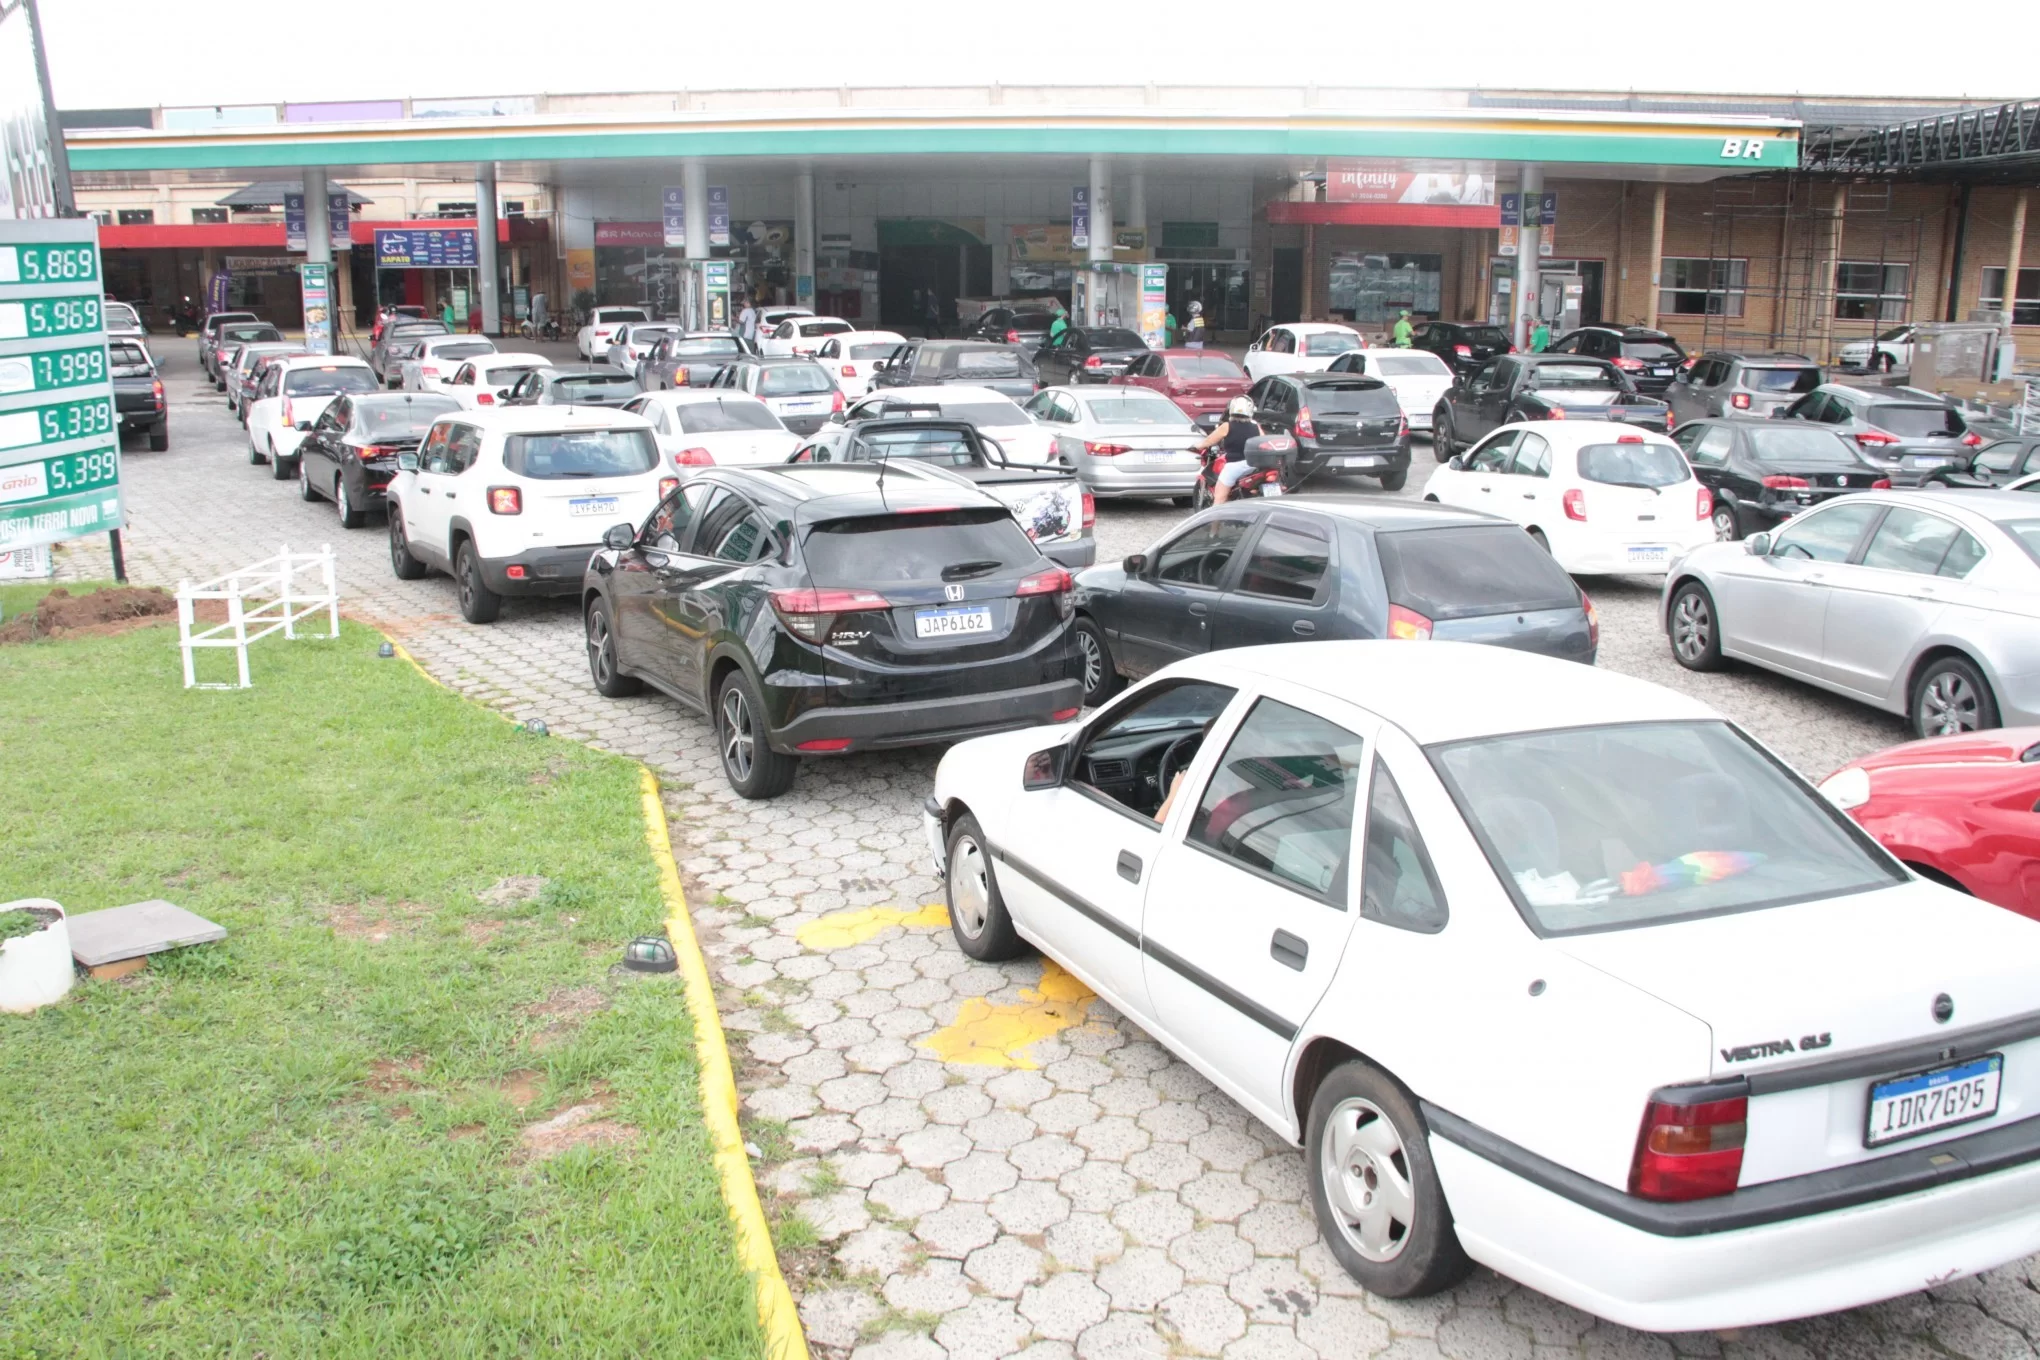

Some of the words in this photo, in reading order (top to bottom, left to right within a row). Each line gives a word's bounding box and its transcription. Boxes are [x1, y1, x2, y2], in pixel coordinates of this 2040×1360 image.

[1720, 138, 1764, 159] BR
[32, 509, 68, 533] TERRA
[70, 504, 98, 527] NOVA
[832, 631, 871, 639] HR-V
[1720, 1038, 1795, 1063] VECTRA
[1799, 1032, 1832, 1051] GLS
[1883, 1079, 1986, 1132] IDR7G95
